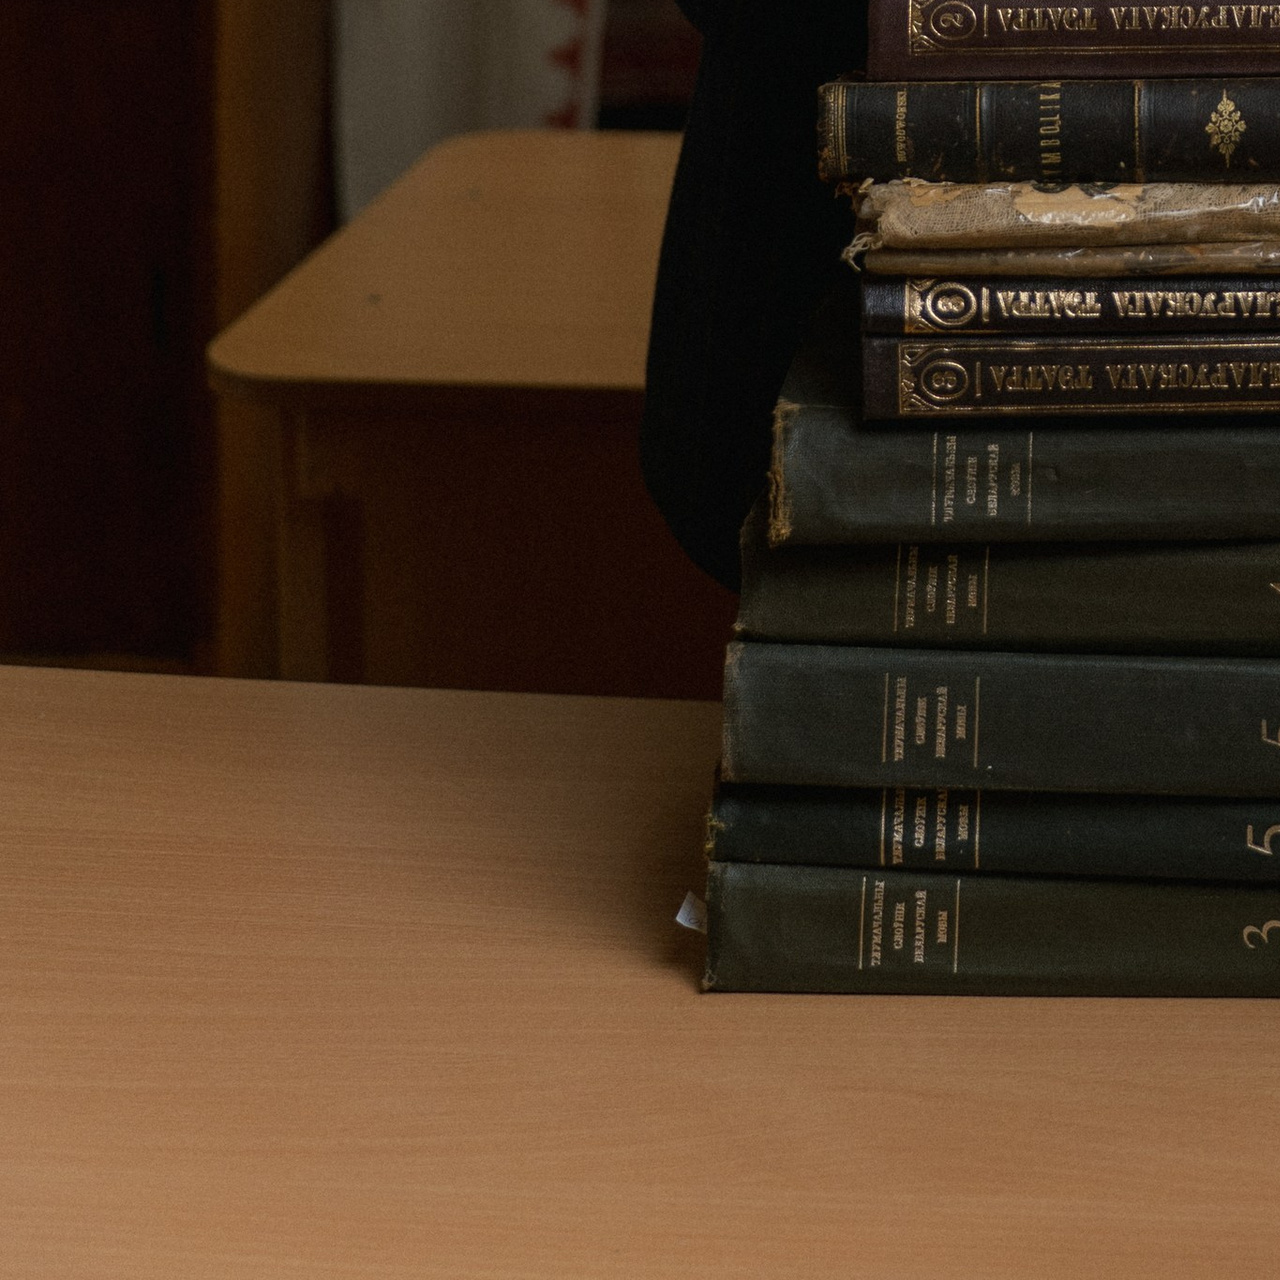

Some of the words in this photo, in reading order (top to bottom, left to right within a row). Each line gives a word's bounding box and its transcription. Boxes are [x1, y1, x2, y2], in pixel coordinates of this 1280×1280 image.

[938, 12, 965, 29] 2
[996, 6, 1098, 32] ТЭАТРА
[1039, 82, 1062, 176] YMBOLIKA
[996, 290, 1101, 319] ТЭАТРА
[990, 364, 1094, 391] ТЭАТРА
